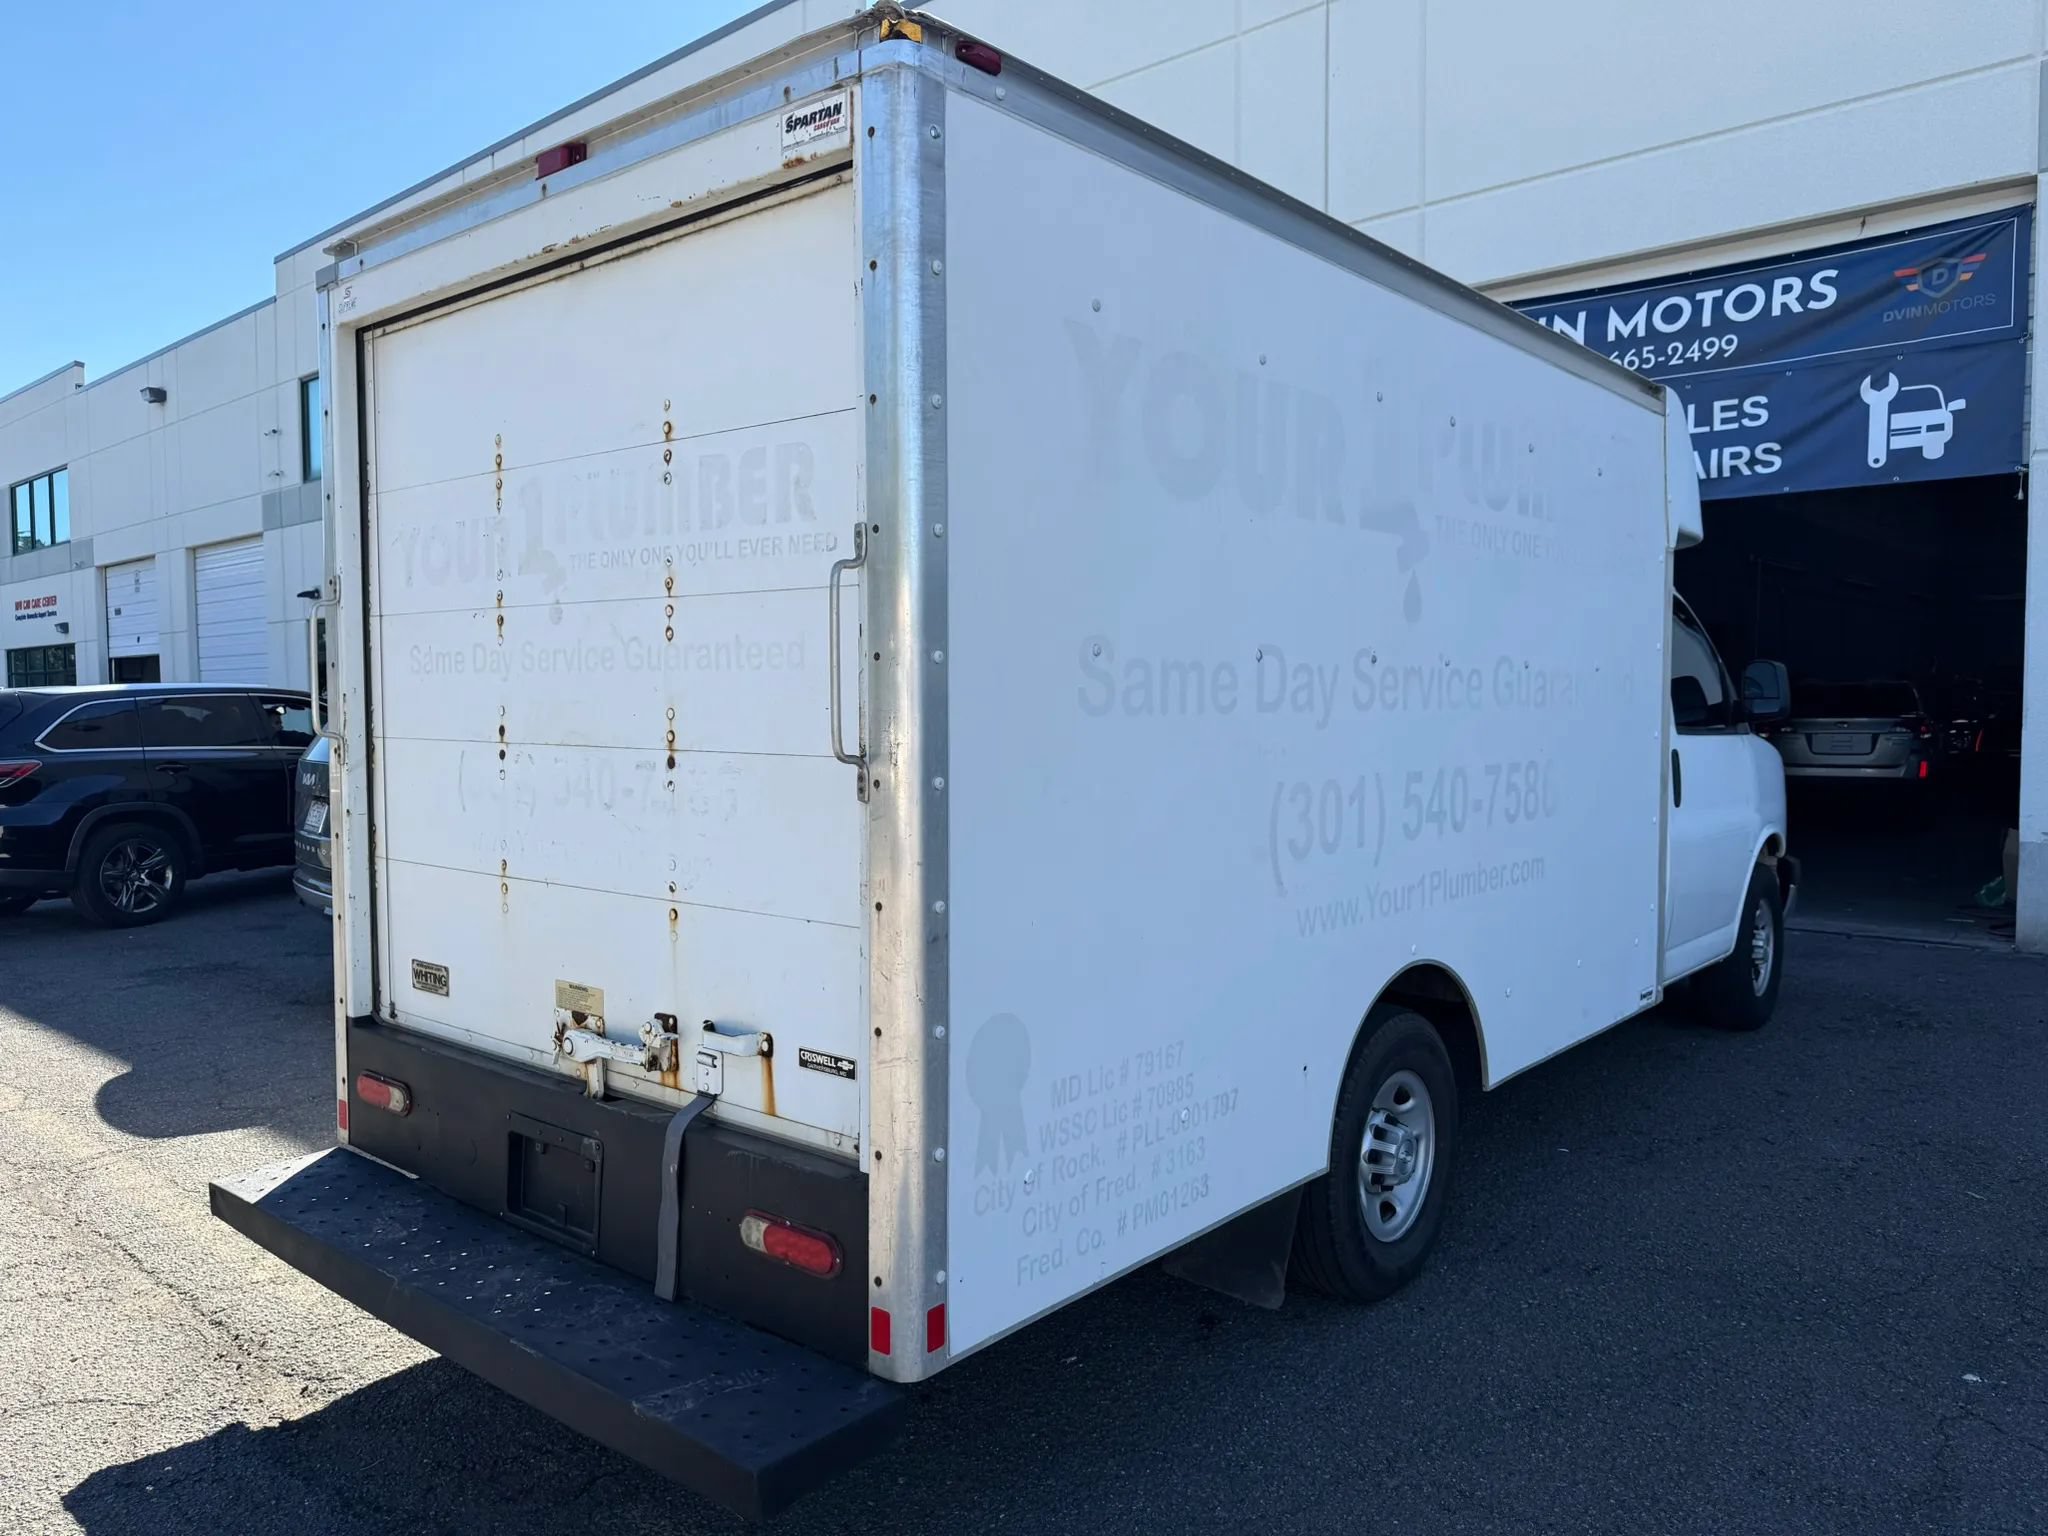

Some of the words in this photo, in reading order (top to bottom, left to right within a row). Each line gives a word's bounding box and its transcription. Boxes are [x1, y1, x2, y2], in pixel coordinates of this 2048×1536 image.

[785, 102, 842, 134] SPARTAN
[1607, 269, 1839, 342] MOTORS
[1061, 315, 1347, 527] YOUR
[1687, 395, 1769, 434] LES
[569, 551, 597, 570] THE
[600, 549, 640, 569] ONLY
[640, 547, 673, 566] ONE
[675, 541, 733, 564] YOU'LL
[737, 537, 784, 558] EVER
[788, 531, 838, 555] NEED
[1471, 519, 1508, 554] ONLY
[1511, 529, 1542, 561] ONE
[410, 642, 466, 676] Same
[472, 641, 513, 682] Day
[520, 638, 615, 673] Service
[618, 630, 807, 673] Guaranteed
[1076, 632, 1240, 718] Same
[1254, 641, 1340, 731] Day
[1351, 646, 1484, 714] Service
[1268, 771, 1388, 898] (301)
[1296, 855, 1546, 940] www.Your1Plumber.com
[413, 968, 447, 987] WHITING
[801, 1051, 836, 1067] CRISWELL
[1051, 1073, 1082, 1112] MD
[1088, 1064, 1115, 1097] Lic
[1119, 1055, 1130, 1087] #
[1135, 1040, 1185, 1082] 79167
[1102, 1098, 1128, 1130] Lic
[1132, 1088, 1143, 1120] #
[974, 1175, 1017, 1218] City
[1116, 1129, 1128, 1160] #
[1021, 1200, 1064, 1238] City
[1069, 1180, 1089, 1218] of
[1151, 1151, 1162, 1183] #
[1165, 1134, 1206, 1176] 3163
[1076, 1225, 1107, 1258] Co.
[1116, 1207, 1128, 1240] #
